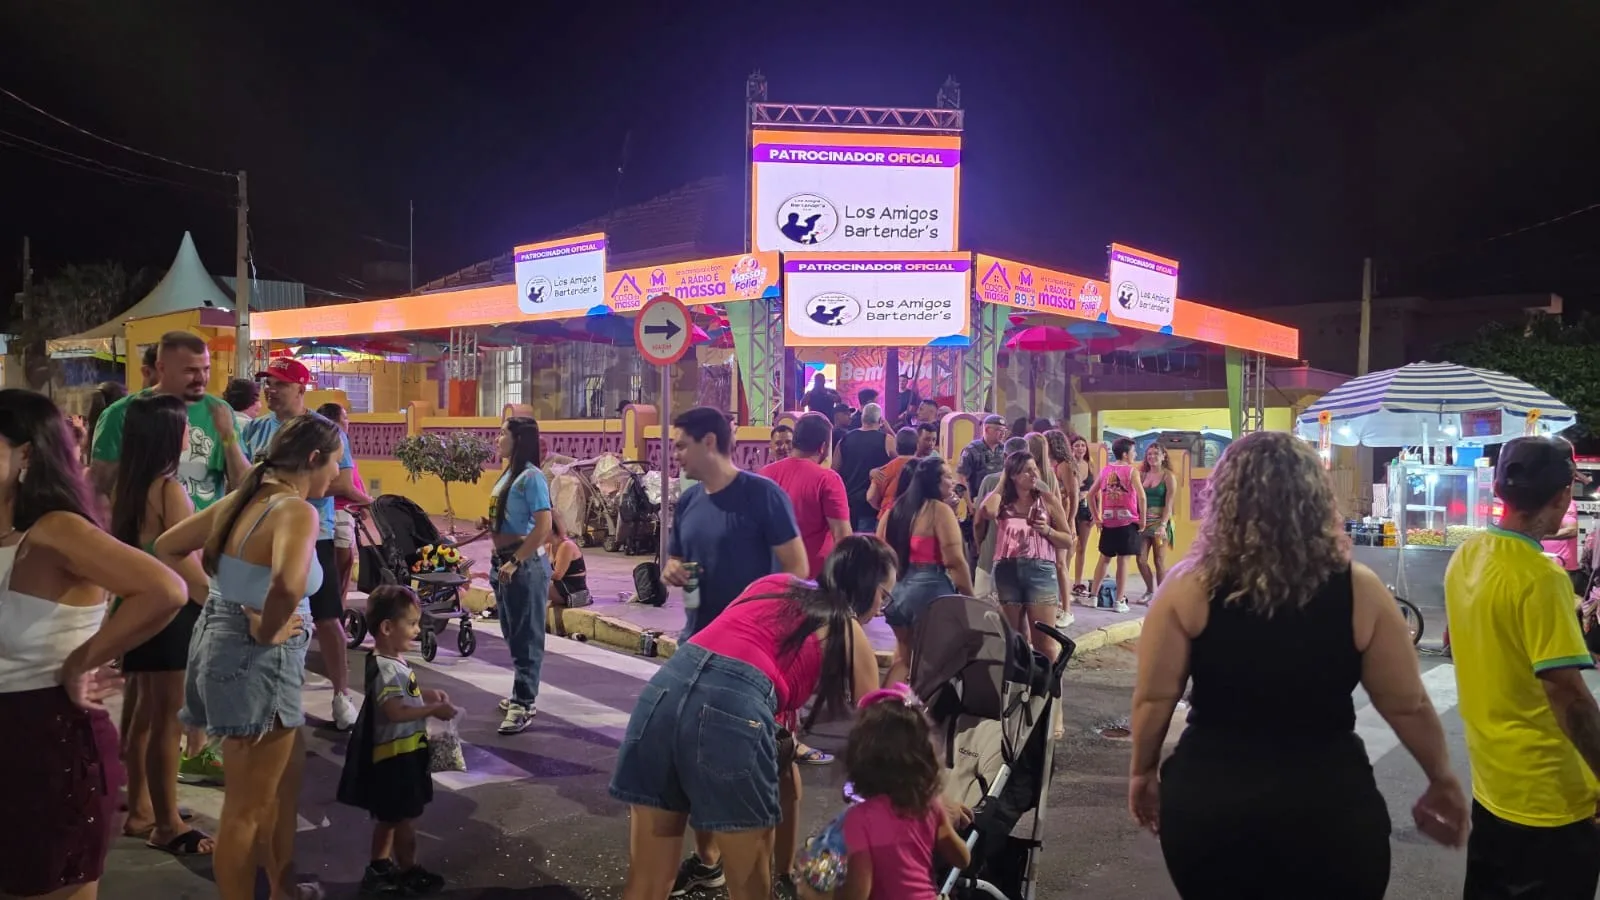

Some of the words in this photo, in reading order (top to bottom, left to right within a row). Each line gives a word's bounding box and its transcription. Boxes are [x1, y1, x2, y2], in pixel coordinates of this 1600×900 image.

[769, 149, 885, 163] PATROCINADOR
[888, 152, 943, 164] OFICIAL
[845, 205, 875, 219] Los
[879, 204, 938, 225] Amigos
[844, 225, 938, 239] Bartender's
[520, 247, 570, 261] PATROCINADOR
[571, 243, 597, 253] OFICIAL
[798, 263, 901, 271] PATROCINADOR
[904, 263, 955, 271] OFICIAL
[1117, 253, 1156, 270] PATROCINADOR
[553, 279, 568, 287] Los
[570, 275, 597, 286] Amigos
[681, 277, 686, 285] A
[688, 274, 712, 285] RÁDIO
[714, 272, 719, 281] É
[735, 278, 758, 291] Folia
[554, 285, 598, 297] Bartender's
[675, 281, 726, 299] massa
[1044, 284, 1048, 292] A
[985, 291, 1009, 303] massa
[1015, 292, 1035, 307] 89.3
[1039, 292, 1076, 310] massa
[615, 300, 640, 309] massa
[867, 299, 894, 308] Los
[897, 298, 952, 311] Amigos
[866, 311, 952, 321] Bartender's
[840, 361, 883, 381] Bem
